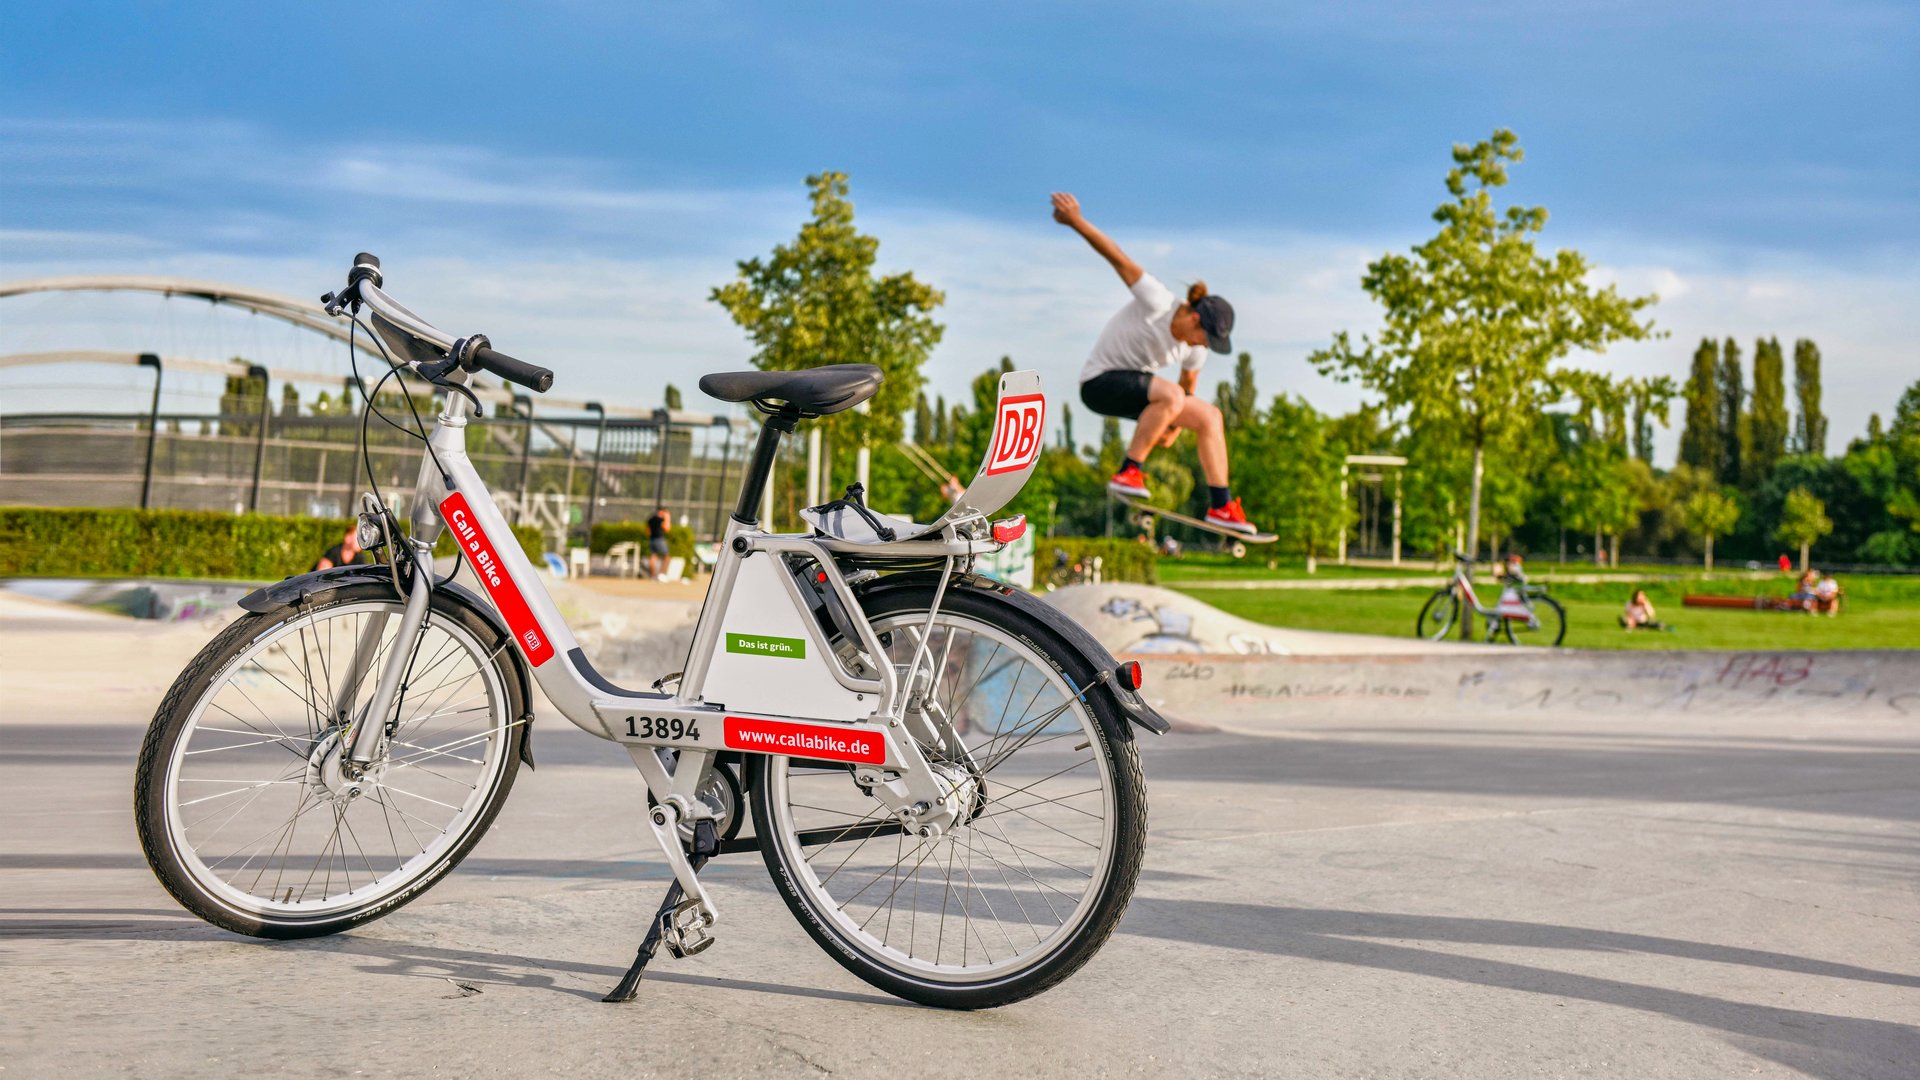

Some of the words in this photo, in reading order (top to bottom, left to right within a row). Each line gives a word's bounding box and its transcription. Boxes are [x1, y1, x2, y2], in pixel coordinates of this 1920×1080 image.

[995, 407, 1039, 463] DB
[452, 509, 477, 541] Call
[469, 540, 480, 552] a
[476, 549, 501, 588] Bike
[525, 631, 539, 649] DB
[738, 639, 755, 649] Das
[757, 640, 768, 650] ist
[769, 642, 793, 652] grün.
[1019, 633, 1064, 672] SCHWALBE
[625, 716, 700, 741] 13894
[738, 730, 870, 755] www.callabike.de
[1085, 703, 1113, 759] MARATHON
